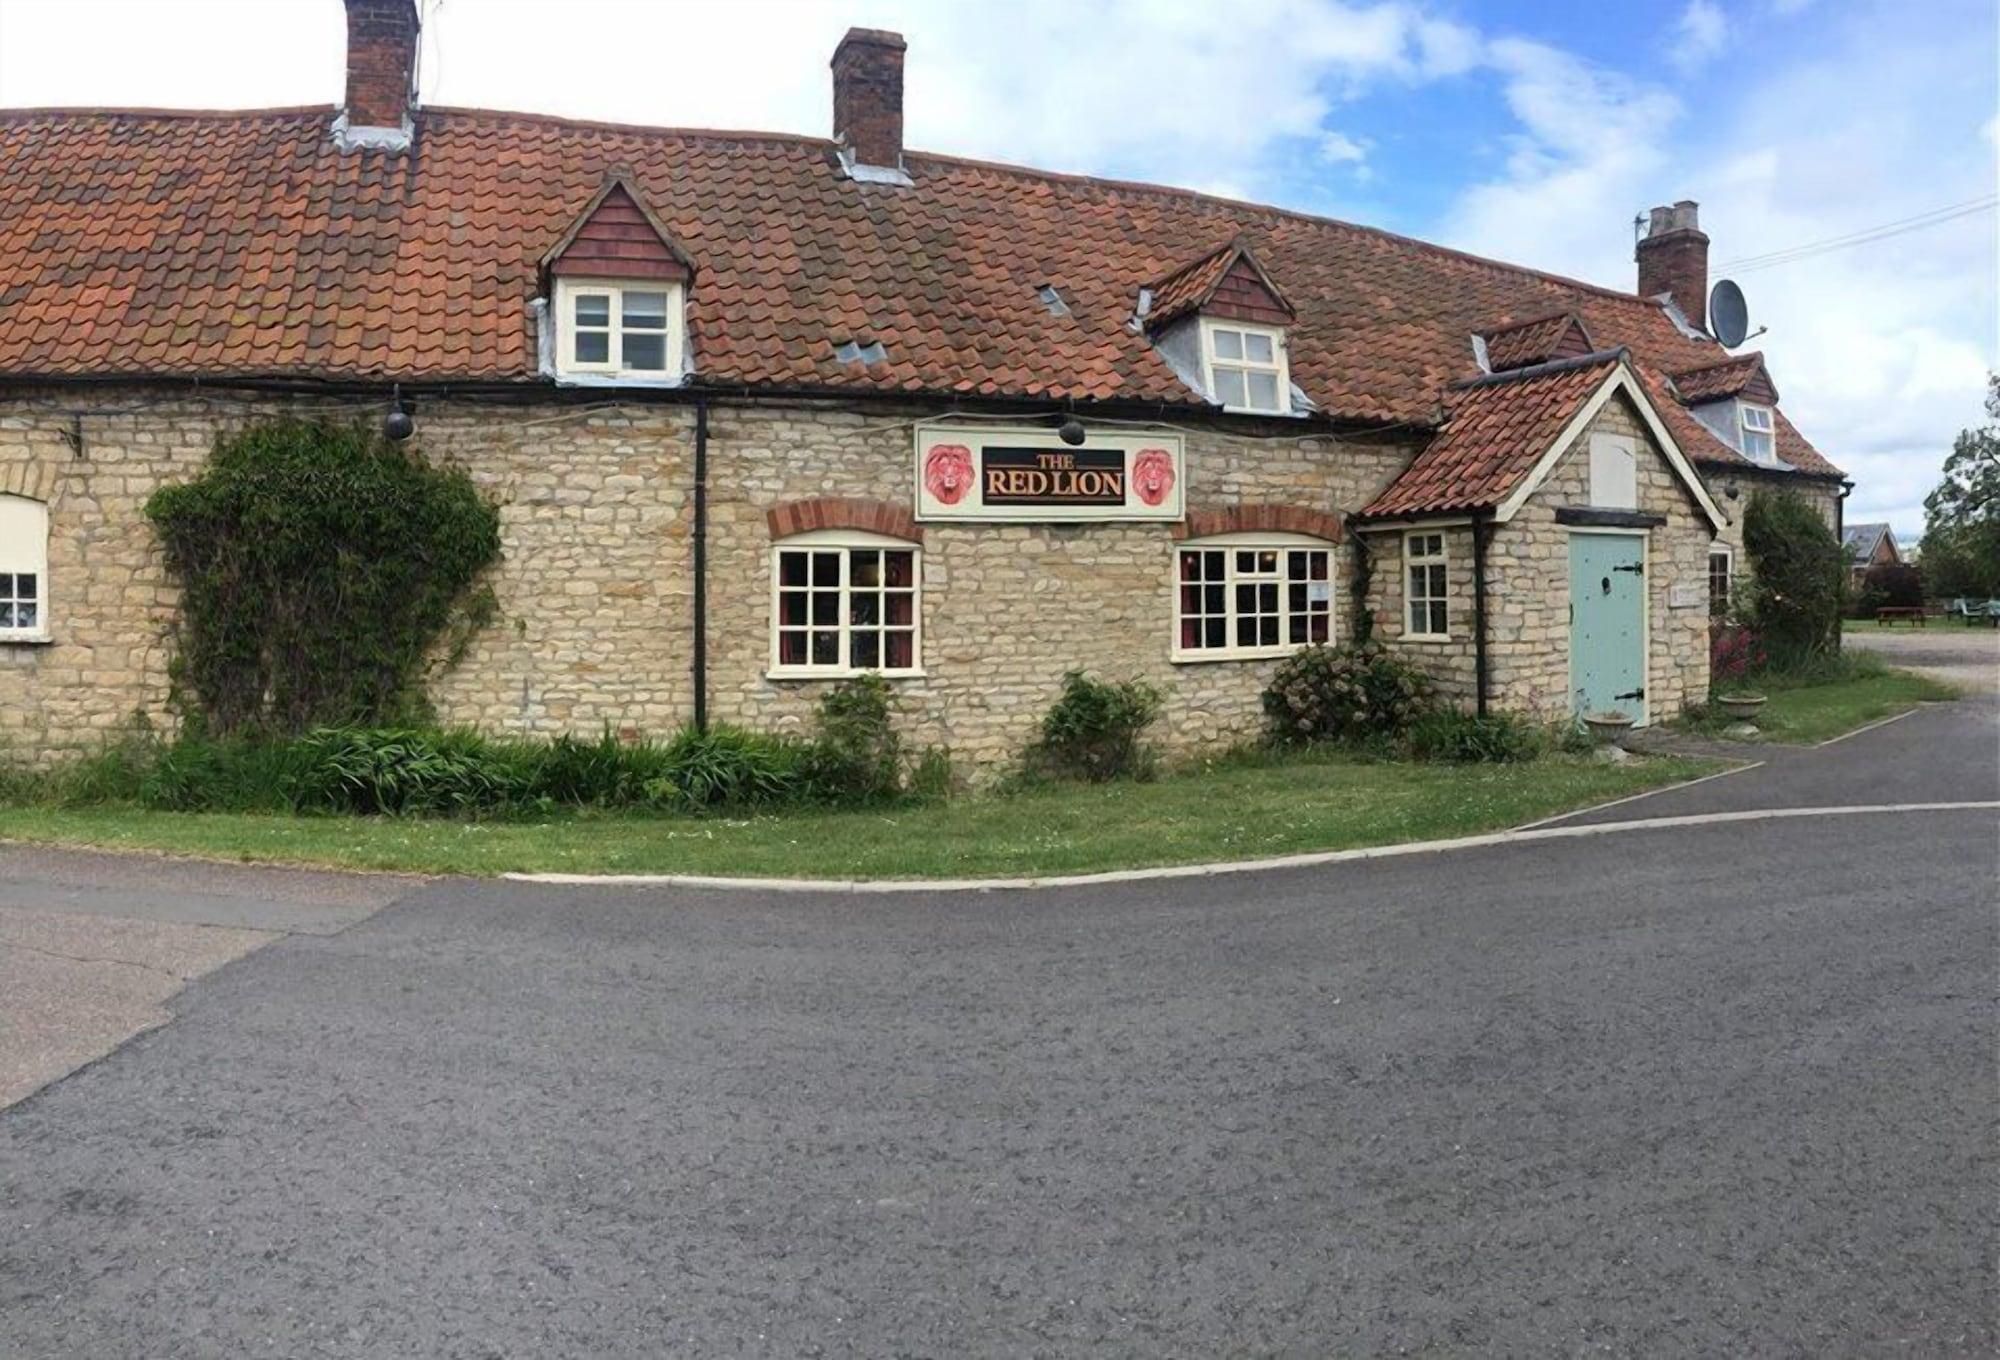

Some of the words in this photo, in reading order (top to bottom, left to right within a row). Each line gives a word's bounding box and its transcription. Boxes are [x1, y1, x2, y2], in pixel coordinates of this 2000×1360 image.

[1037, 454, 1074, 470] THE
[987, 471, 1048, 495] RED
[1052, 471, 1124, 496] LION
